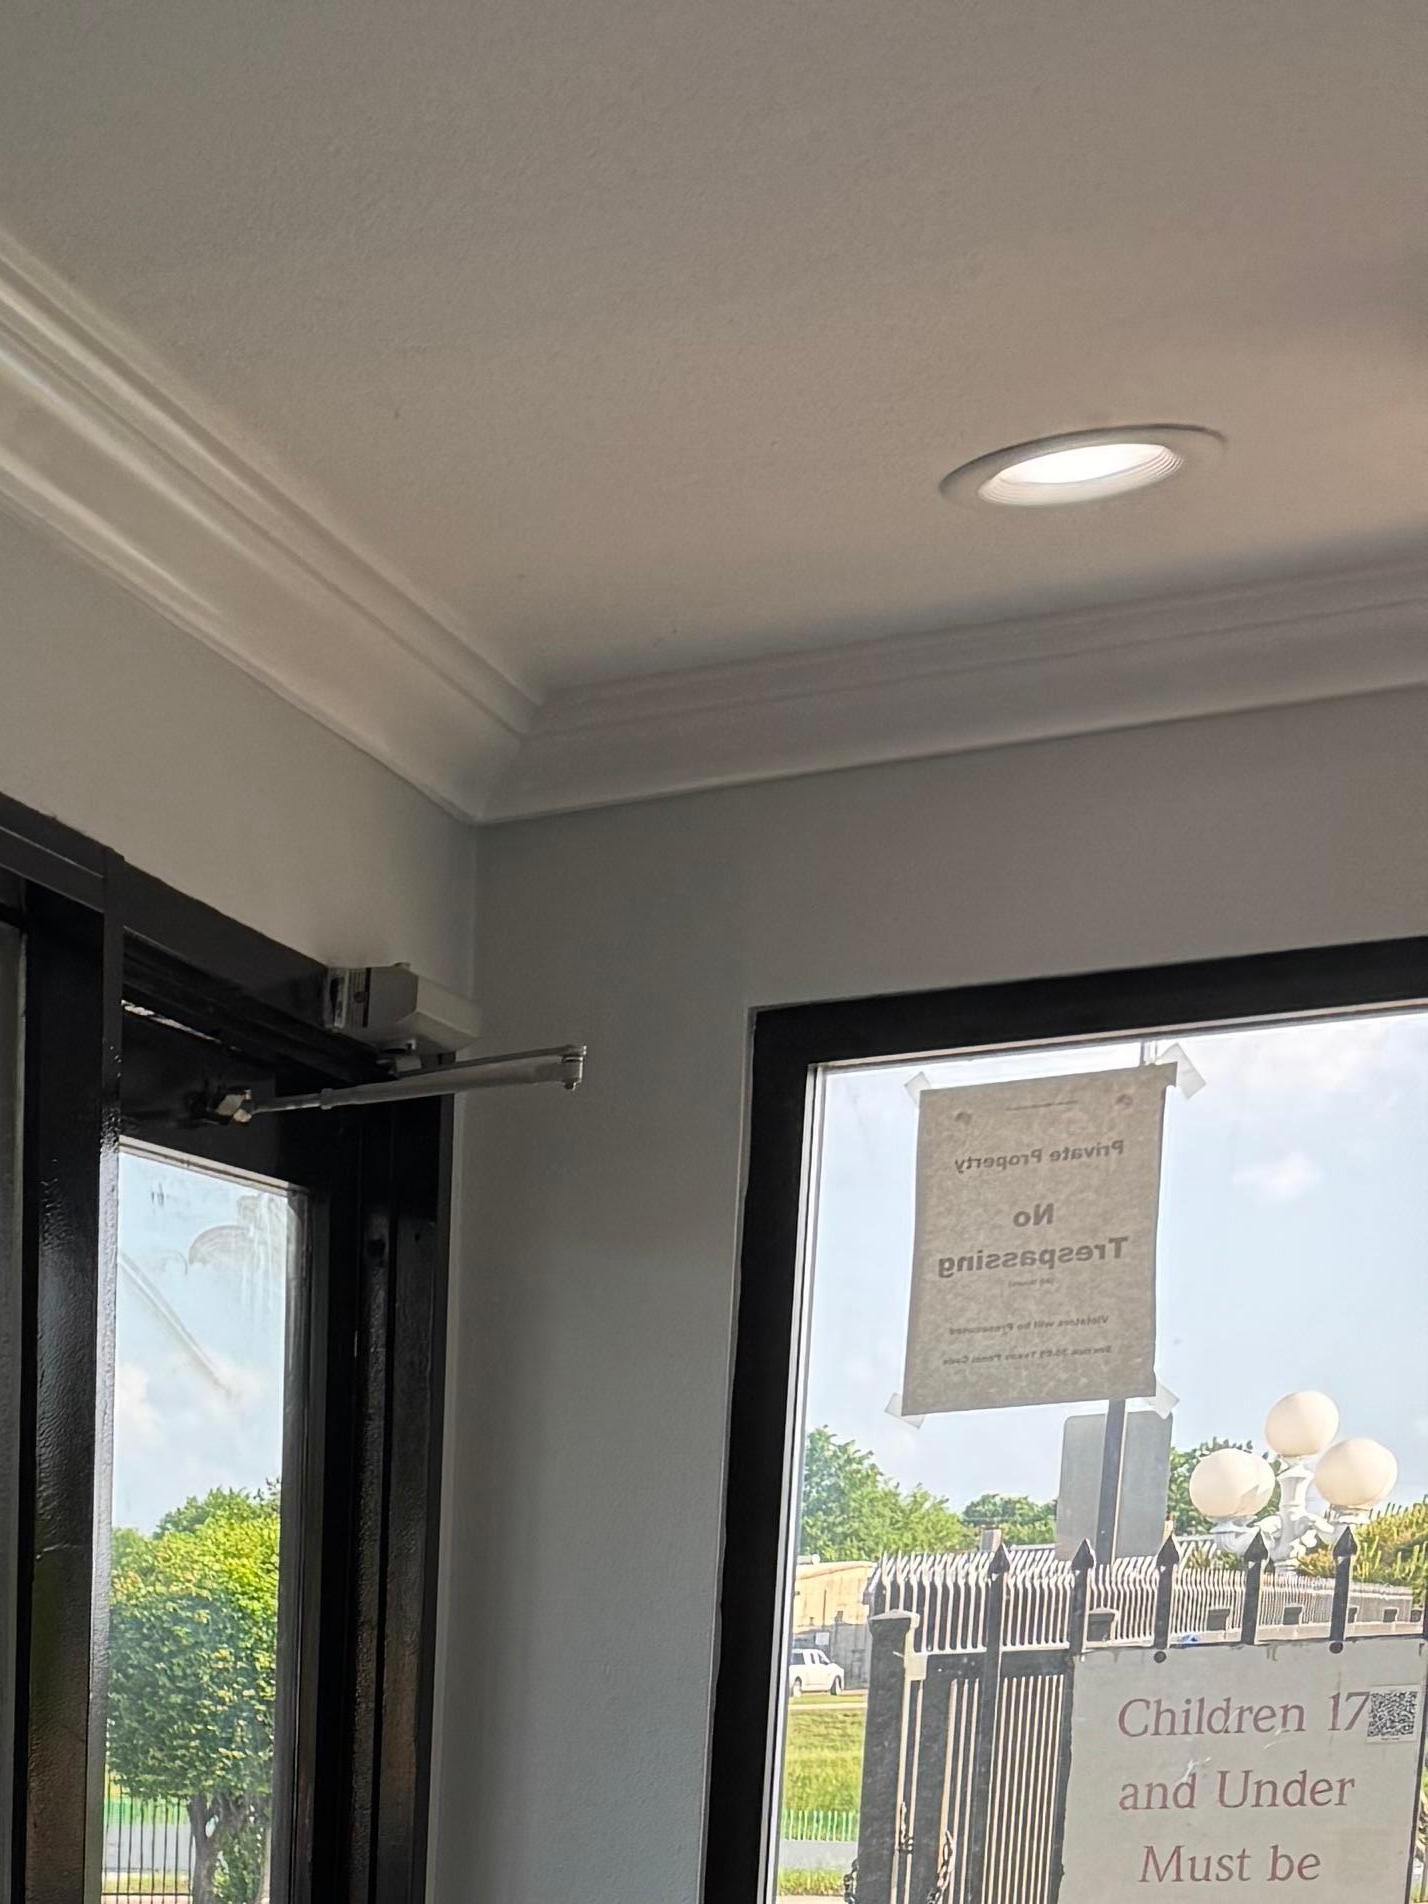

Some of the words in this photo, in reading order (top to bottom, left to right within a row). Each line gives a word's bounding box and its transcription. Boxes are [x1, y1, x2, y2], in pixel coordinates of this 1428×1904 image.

[1117, 1696, 1307, 1738] Children
[1327, 1691, 1370, 1732] 17
[1118, 1770, 1197, 1811] and
[1216, 1769, 1356, 1808] Under
[1138, 1844, 1252, 1883] Must
[1266, 1844, 1322, 1882] be
